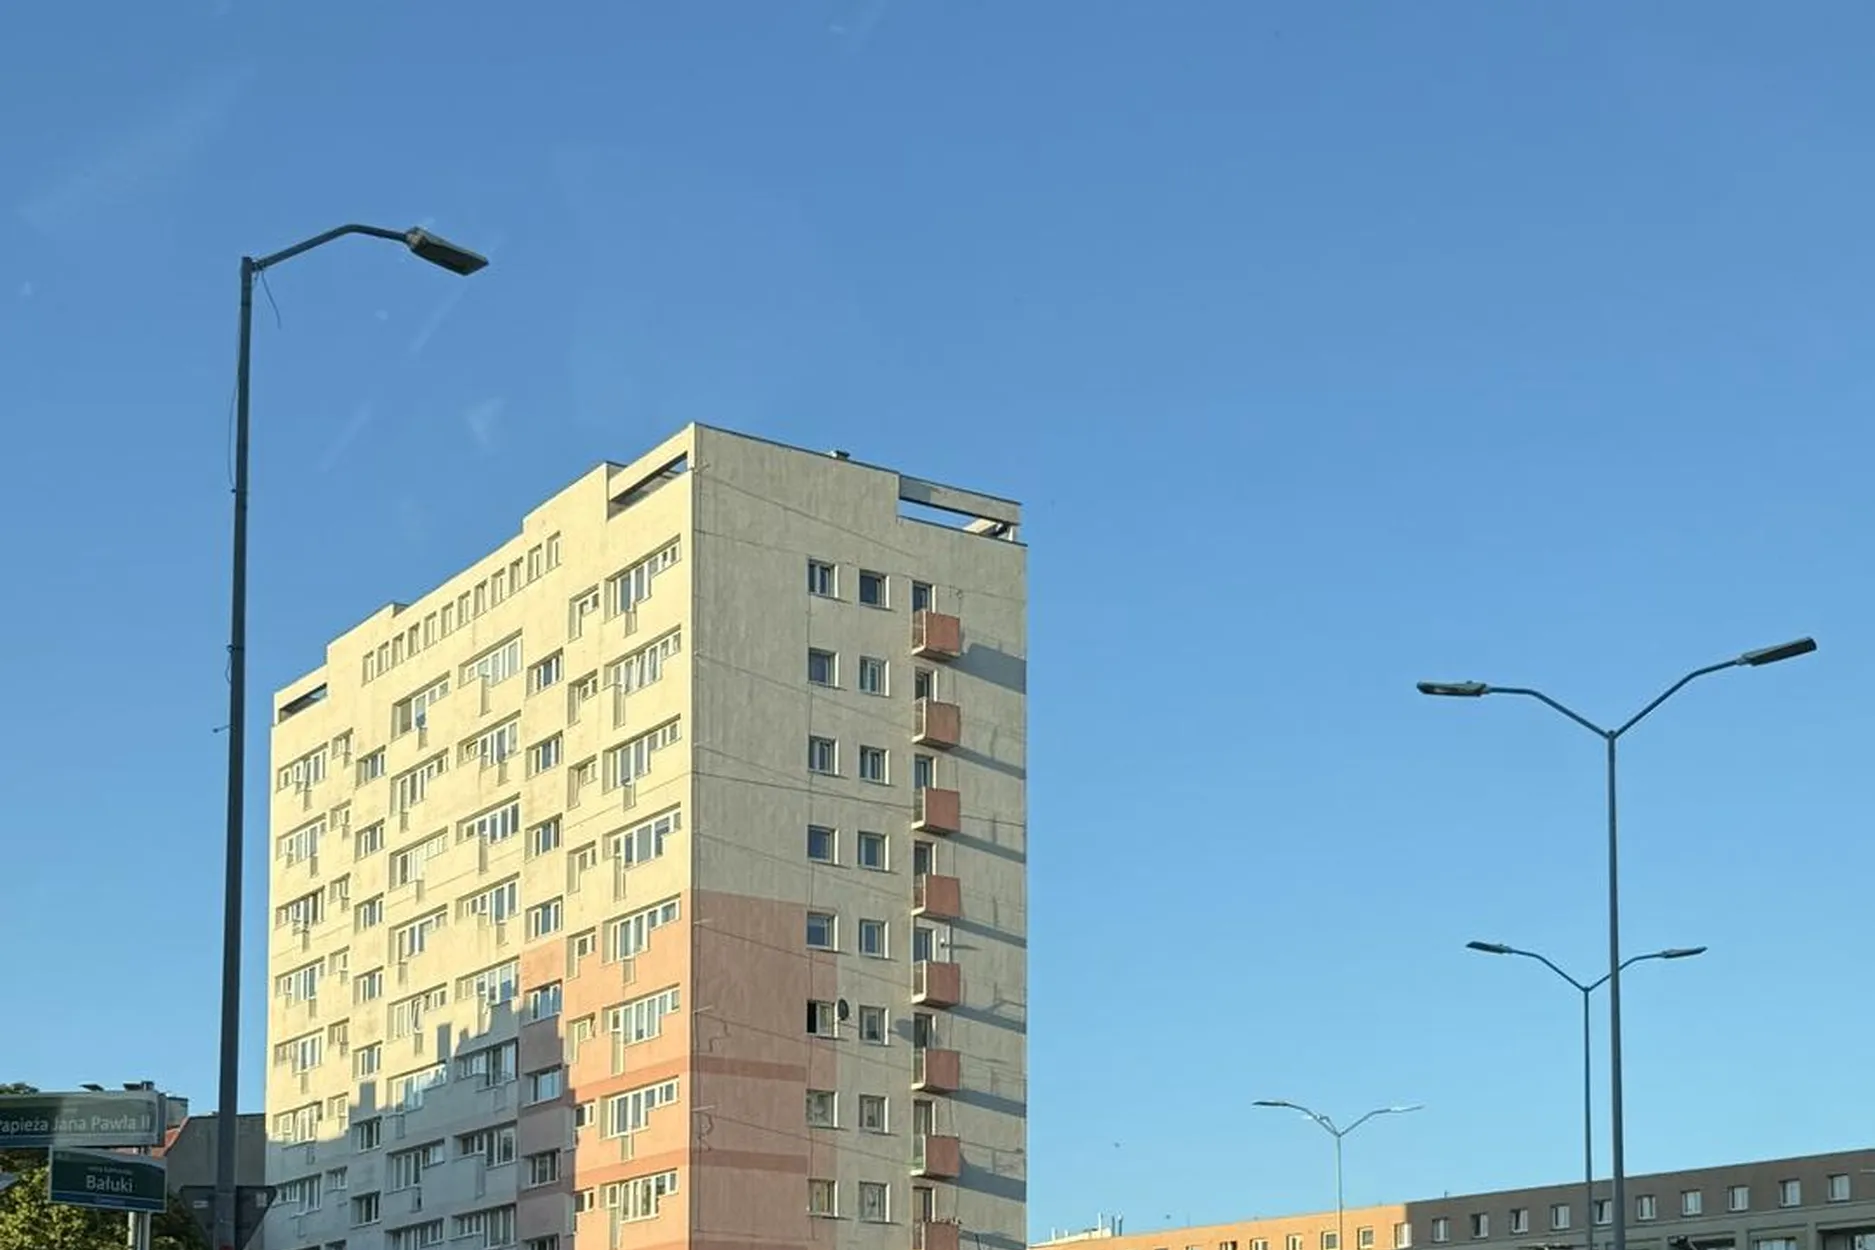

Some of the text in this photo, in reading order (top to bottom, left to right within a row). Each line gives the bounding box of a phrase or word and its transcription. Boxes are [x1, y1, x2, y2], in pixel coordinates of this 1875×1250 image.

[53, 1115, 86, 1132] Jana
[91, 1115, 136, 1131] Pawła
[86, 1175, 134, 1193] Bałuki
